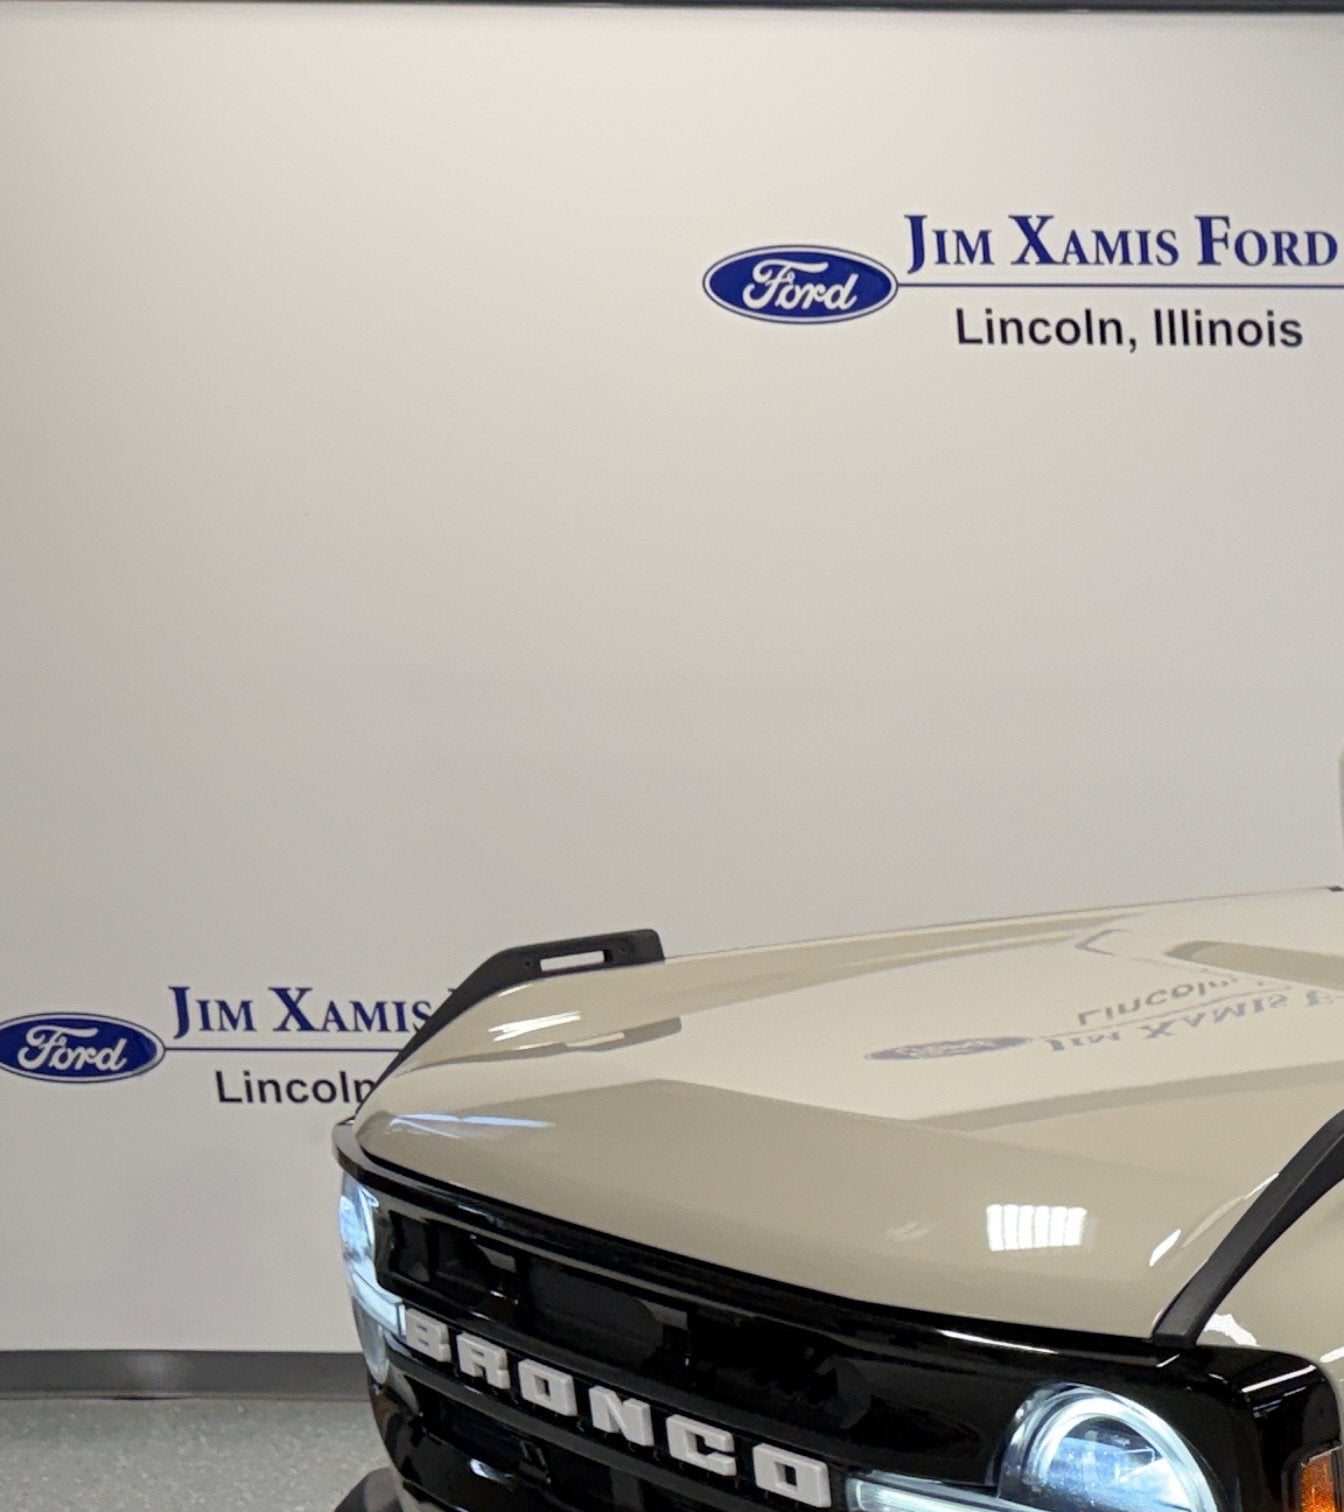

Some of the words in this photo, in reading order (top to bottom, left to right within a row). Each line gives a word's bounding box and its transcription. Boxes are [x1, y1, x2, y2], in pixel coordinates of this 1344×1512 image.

[741, 258, 859, 312] Ford
[956, 307, 1137, 353] Lincoln,
[1154, 308, 1303, 349] Illinois
[16, 1024, 128, 1072] Ford
[403, 1307, 833, 1509] BRONCO
